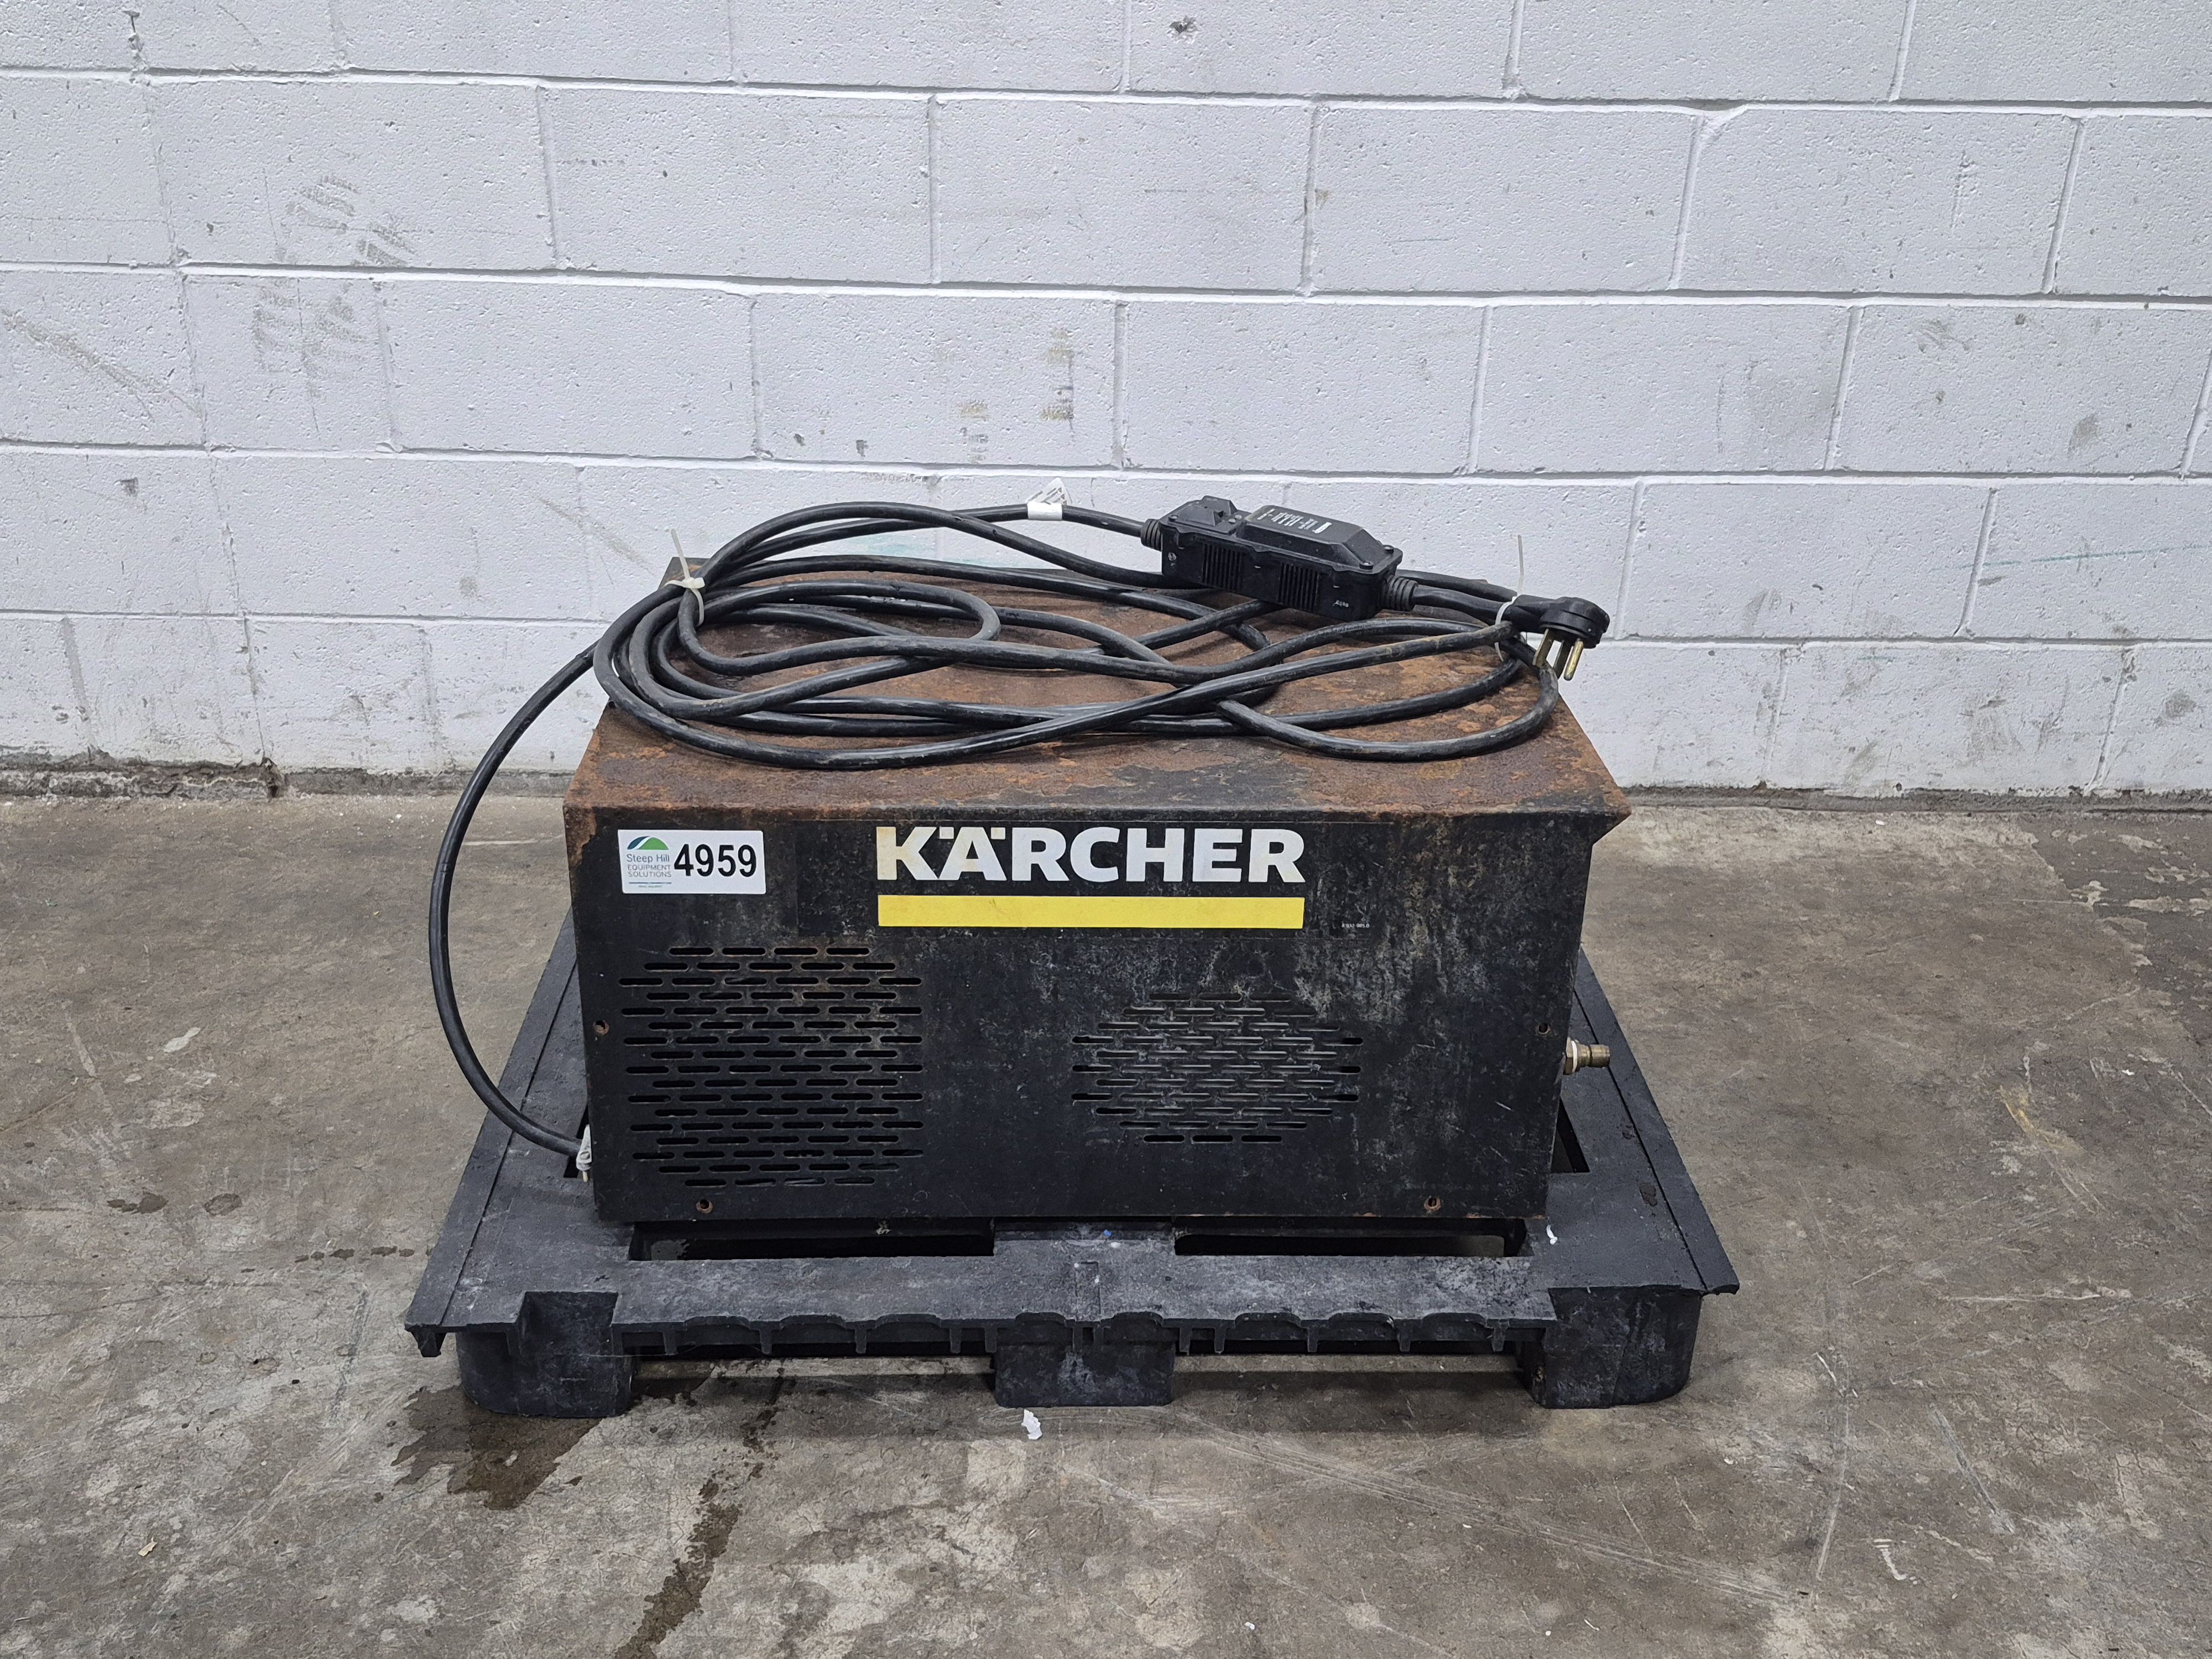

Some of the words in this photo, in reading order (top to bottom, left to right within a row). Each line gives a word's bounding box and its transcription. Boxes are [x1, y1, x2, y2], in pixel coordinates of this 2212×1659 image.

[627, 853, 653, 863] Steep
[656, 854, 670, 862] Hill
[674, 844, 757, 877] 4959
[877, 826, 1306, 883] KÄRCHER
